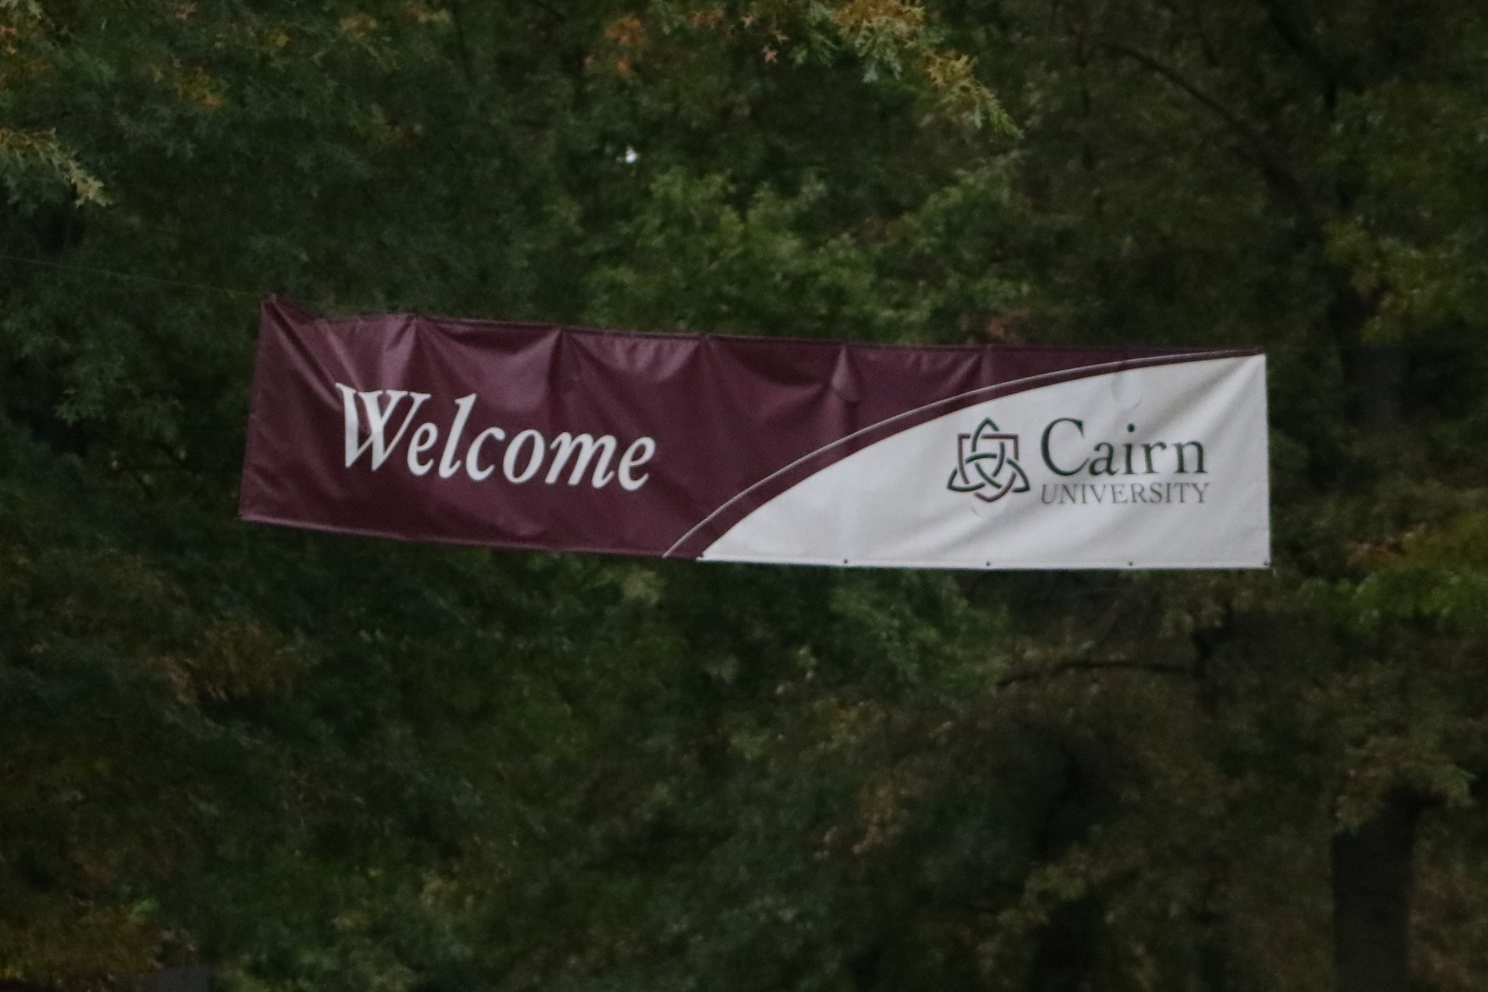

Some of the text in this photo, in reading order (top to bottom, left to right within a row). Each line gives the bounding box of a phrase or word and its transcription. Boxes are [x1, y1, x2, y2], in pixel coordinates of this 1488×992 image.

[335, 382, 657, 491] Welcome
[1040, 417, 1209, 476] Cairn
[1040, 481, 1210, 504] UNIVERSITY
